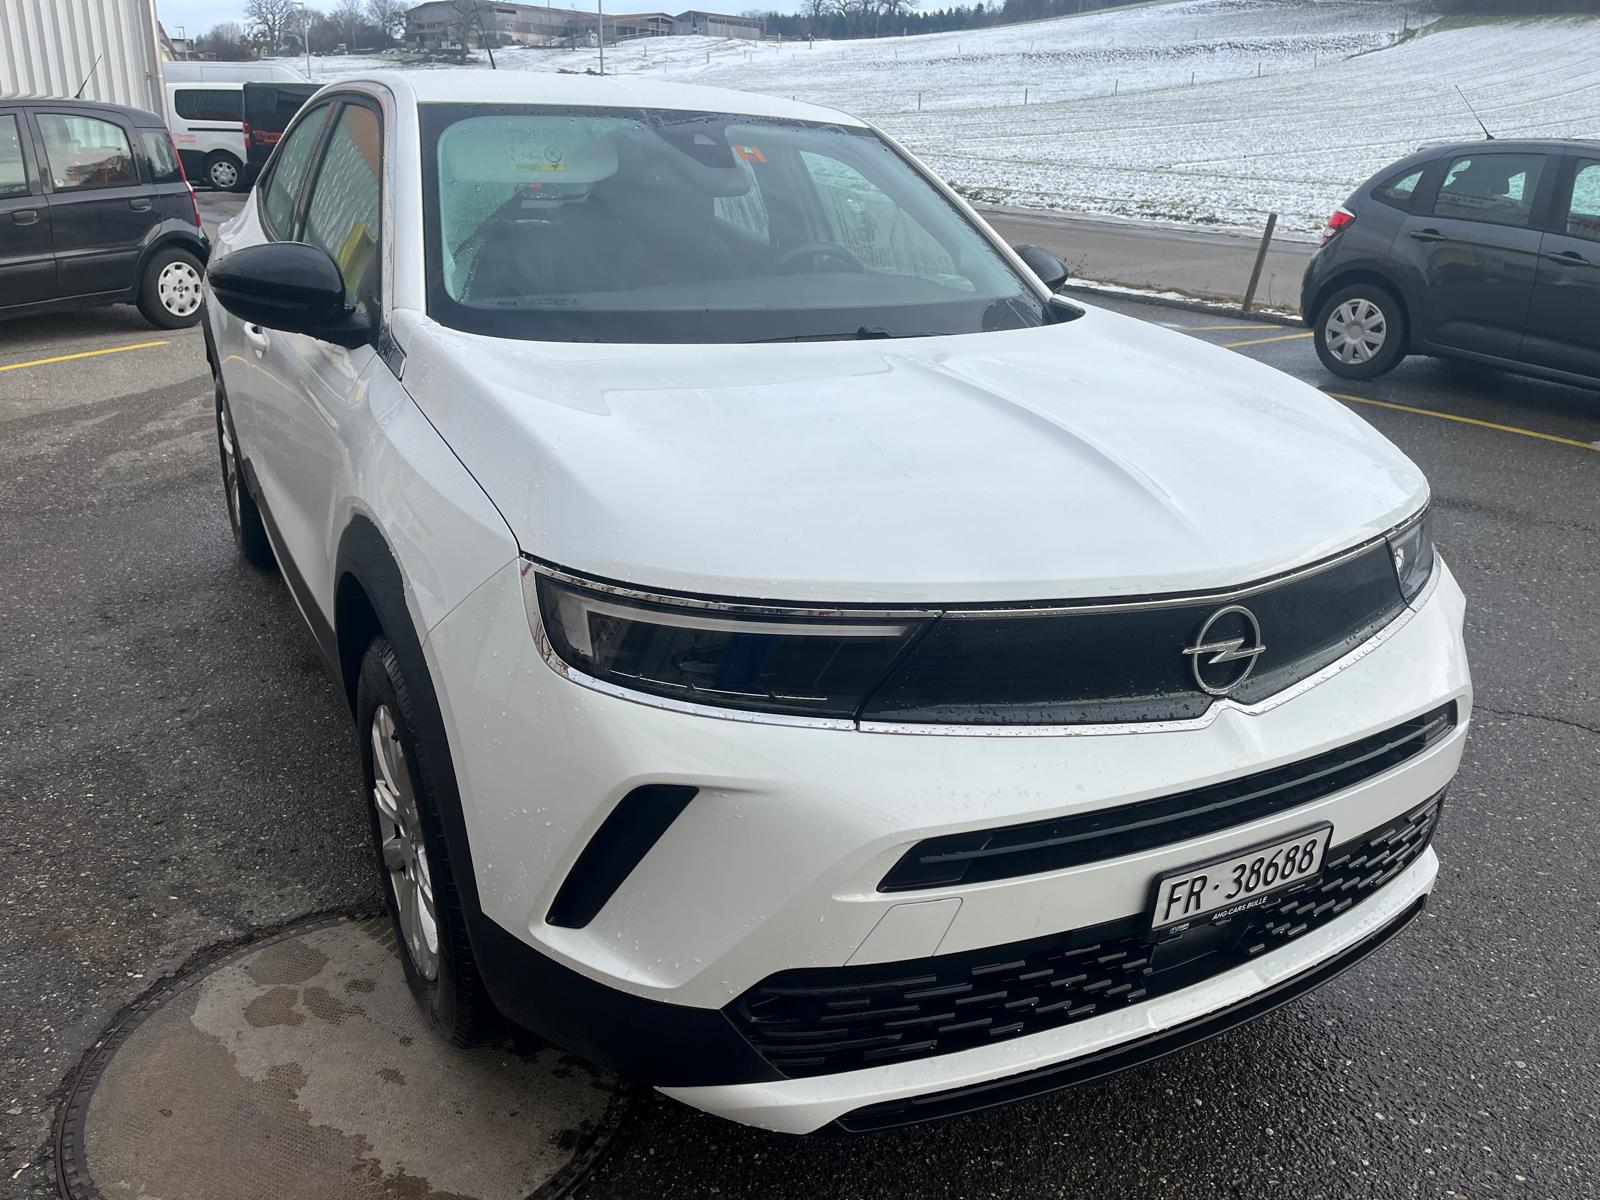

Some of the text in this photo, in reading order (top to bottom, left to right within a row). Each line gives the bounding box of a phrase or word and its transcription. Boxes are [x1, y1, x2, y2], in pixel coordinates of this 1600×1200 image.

[1164, 838, 1318, 920] FR 38688
[1246, 896, 1268, 909] BULLE
